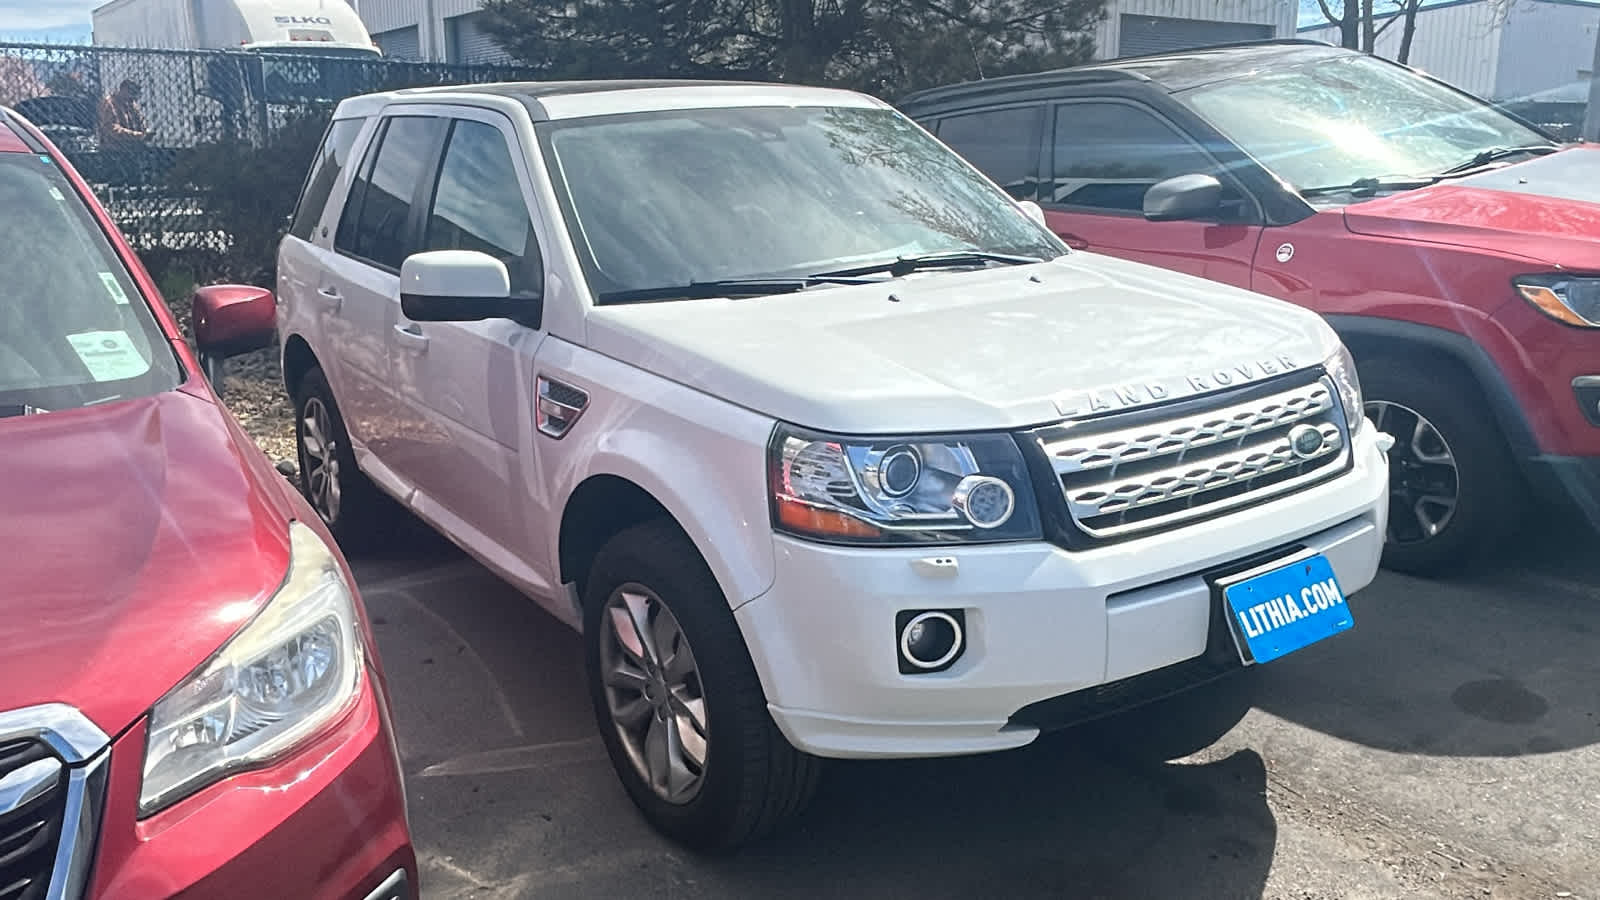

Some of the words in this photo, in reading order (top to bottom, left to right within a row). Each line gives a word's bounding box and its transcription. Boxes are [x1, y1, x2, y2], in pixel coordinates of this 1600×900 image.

[1051, 382, 1169, 417] LAND
[1186, 353, 1298, 391] ROVER
[1239, 578, 1343, 639] LITHIA.COM
